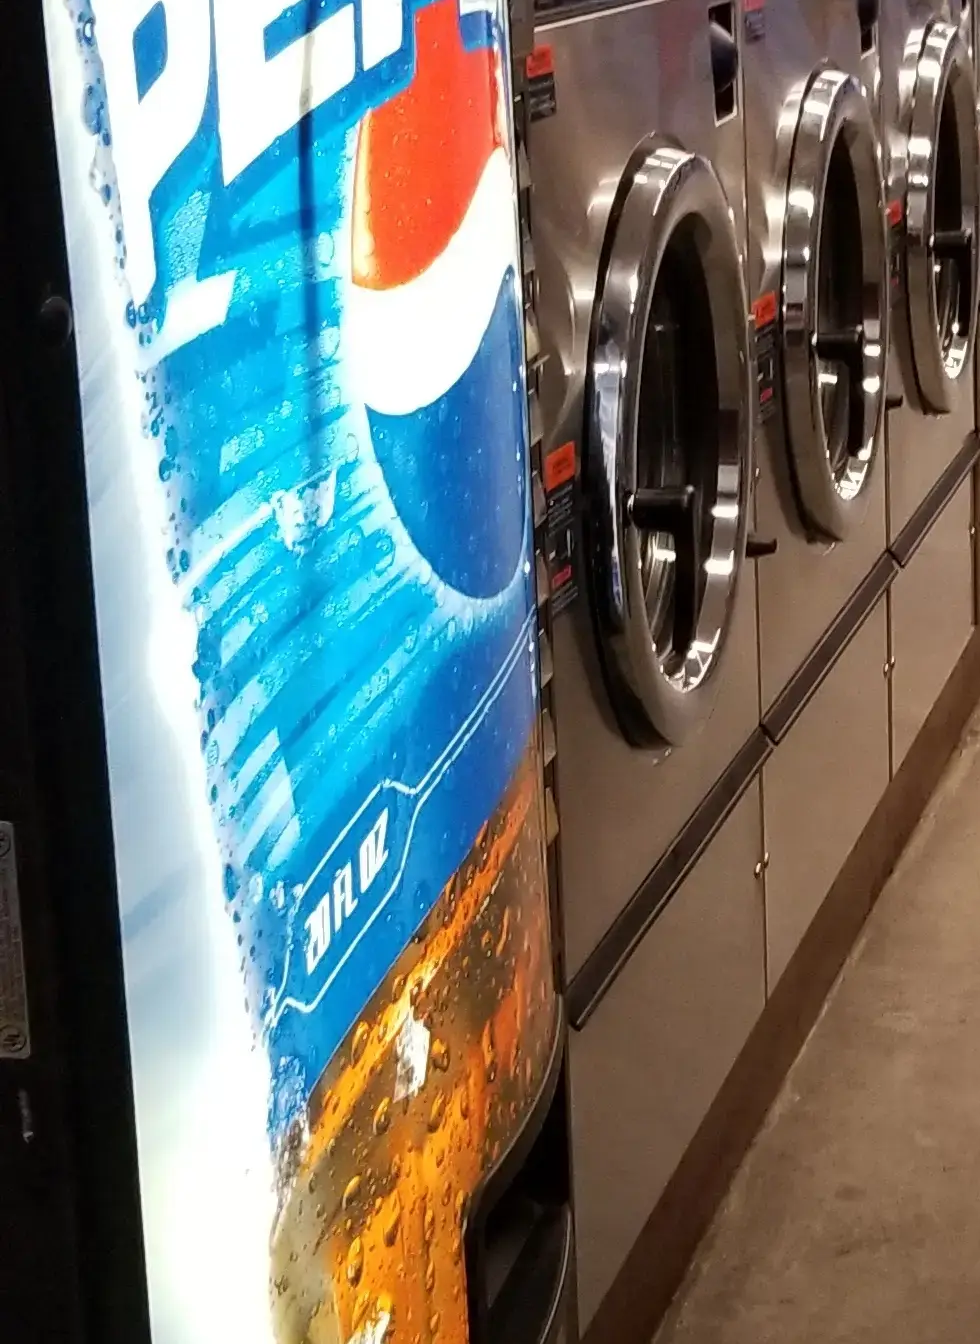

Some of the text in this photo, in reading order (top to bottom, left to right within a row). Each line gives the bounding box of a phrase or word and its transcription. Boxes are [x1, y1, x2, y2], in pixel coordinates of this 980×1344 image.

[304, 807, 389, 976] 20 FL OZ
